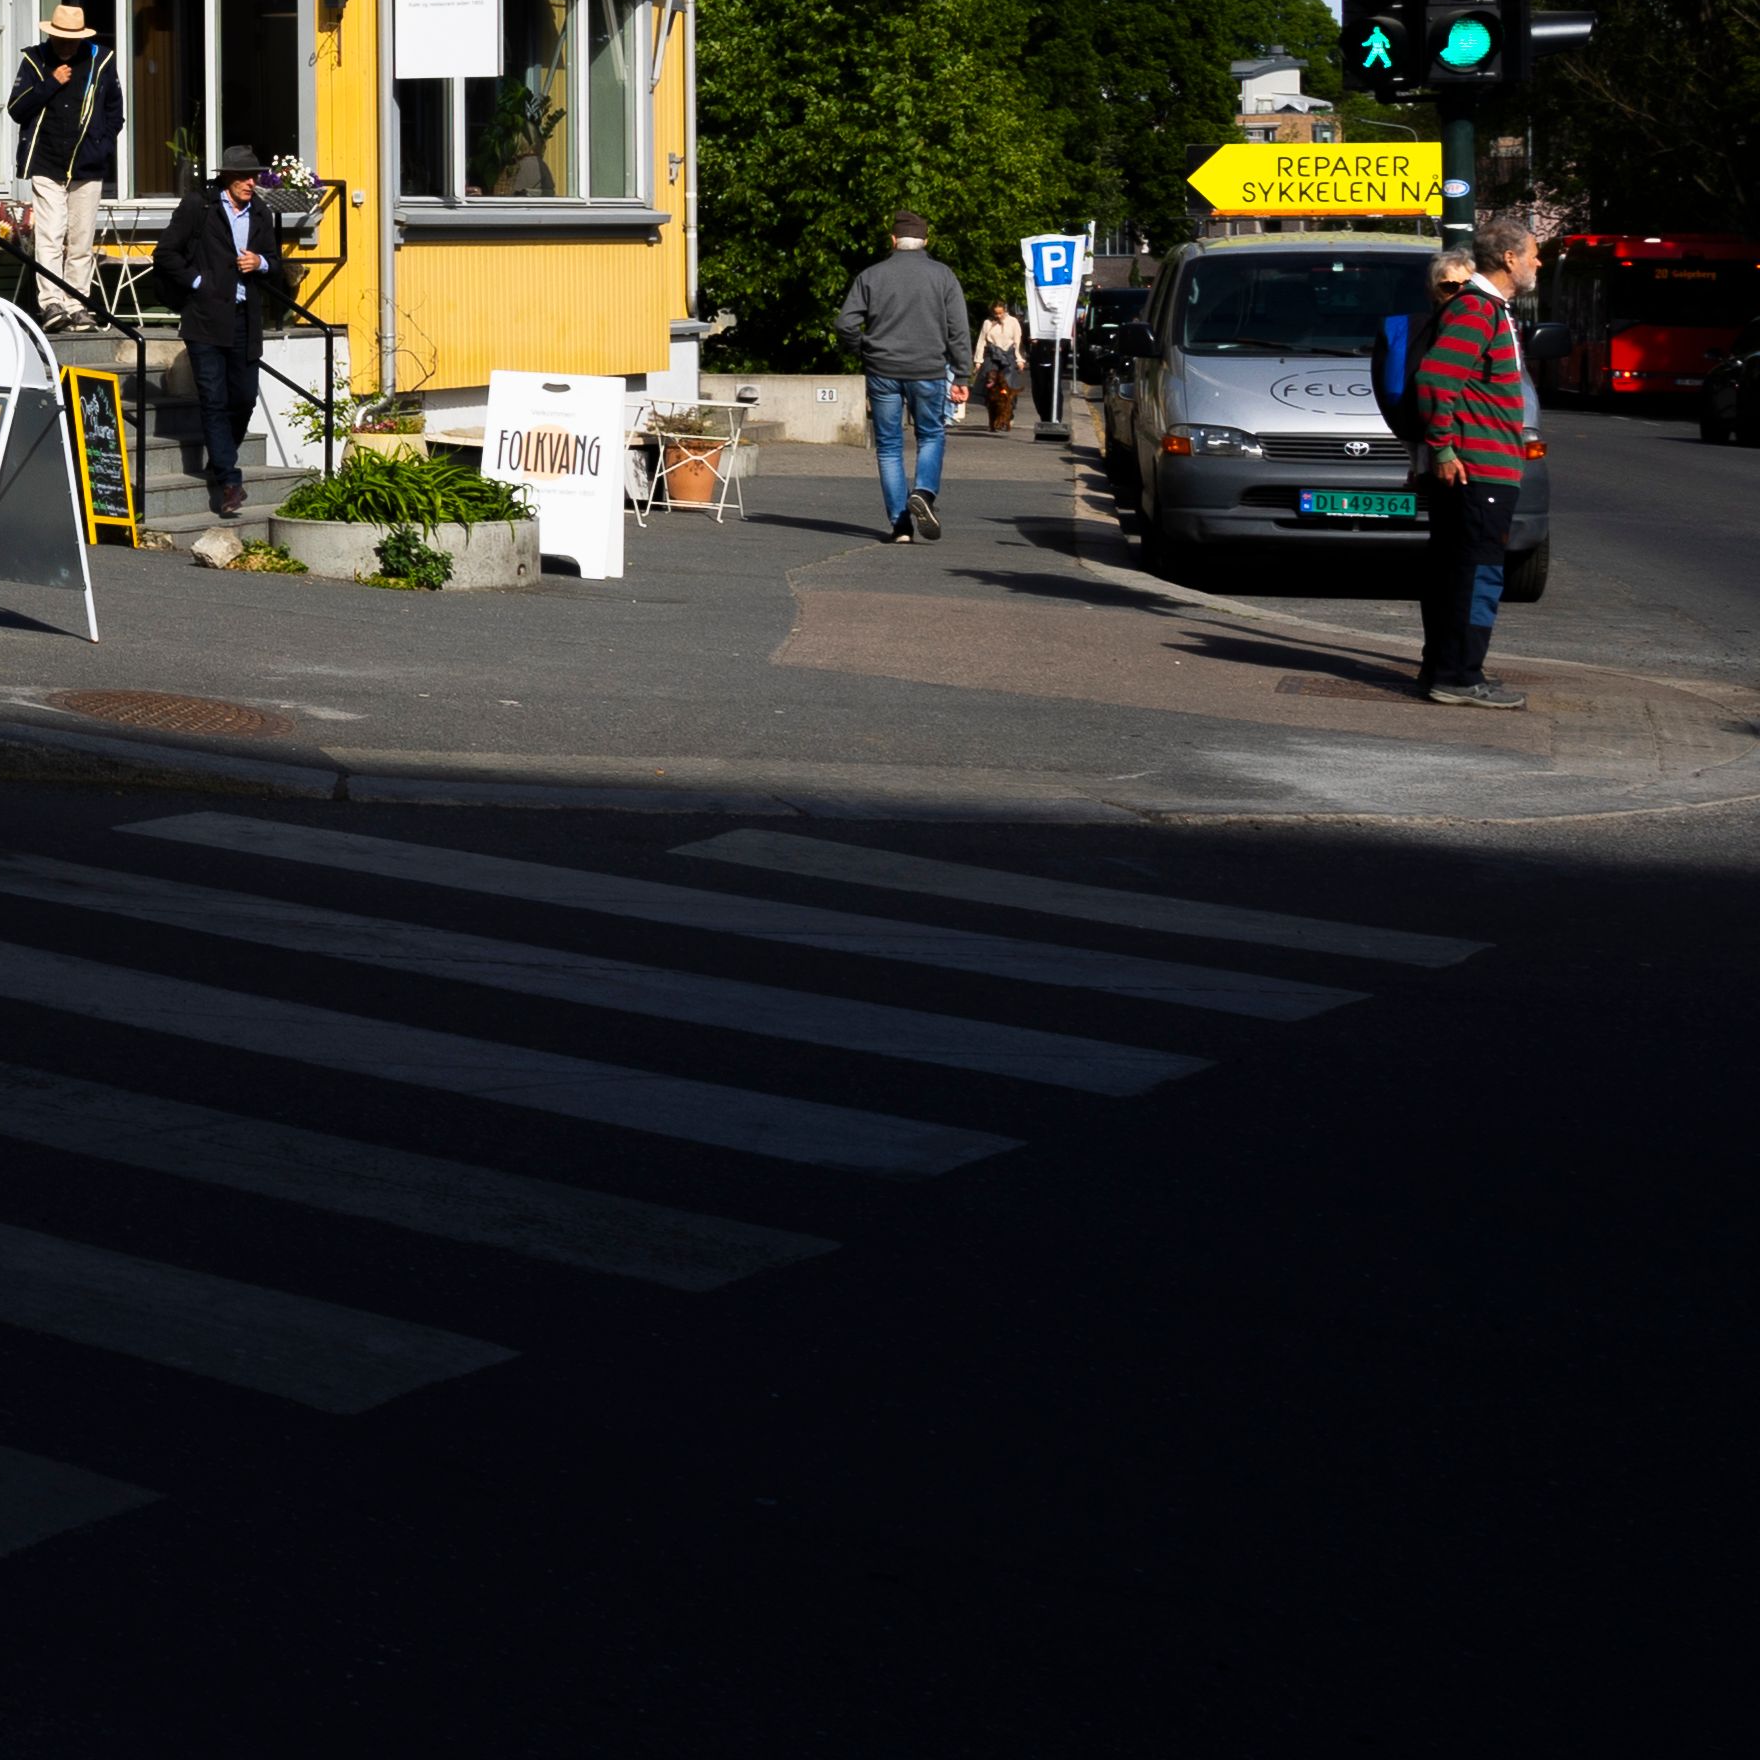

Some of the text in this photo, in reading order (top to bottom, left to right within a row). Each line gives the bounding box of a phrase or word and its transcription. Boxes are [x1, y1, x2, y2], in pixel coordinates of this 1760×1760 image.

[1277, 156, 1410, 177] REPARER
[1242, 175, 1443, 203] SYKKELEN NÅ
[1041, 245, 1067, 282] P
[1654, 268, 1668, 279] 20
[821, 390, 834, 400] 20
[497, 429, 601, 477] FOLKVANG
[1316, 494, 1411, 513] DL 49364
